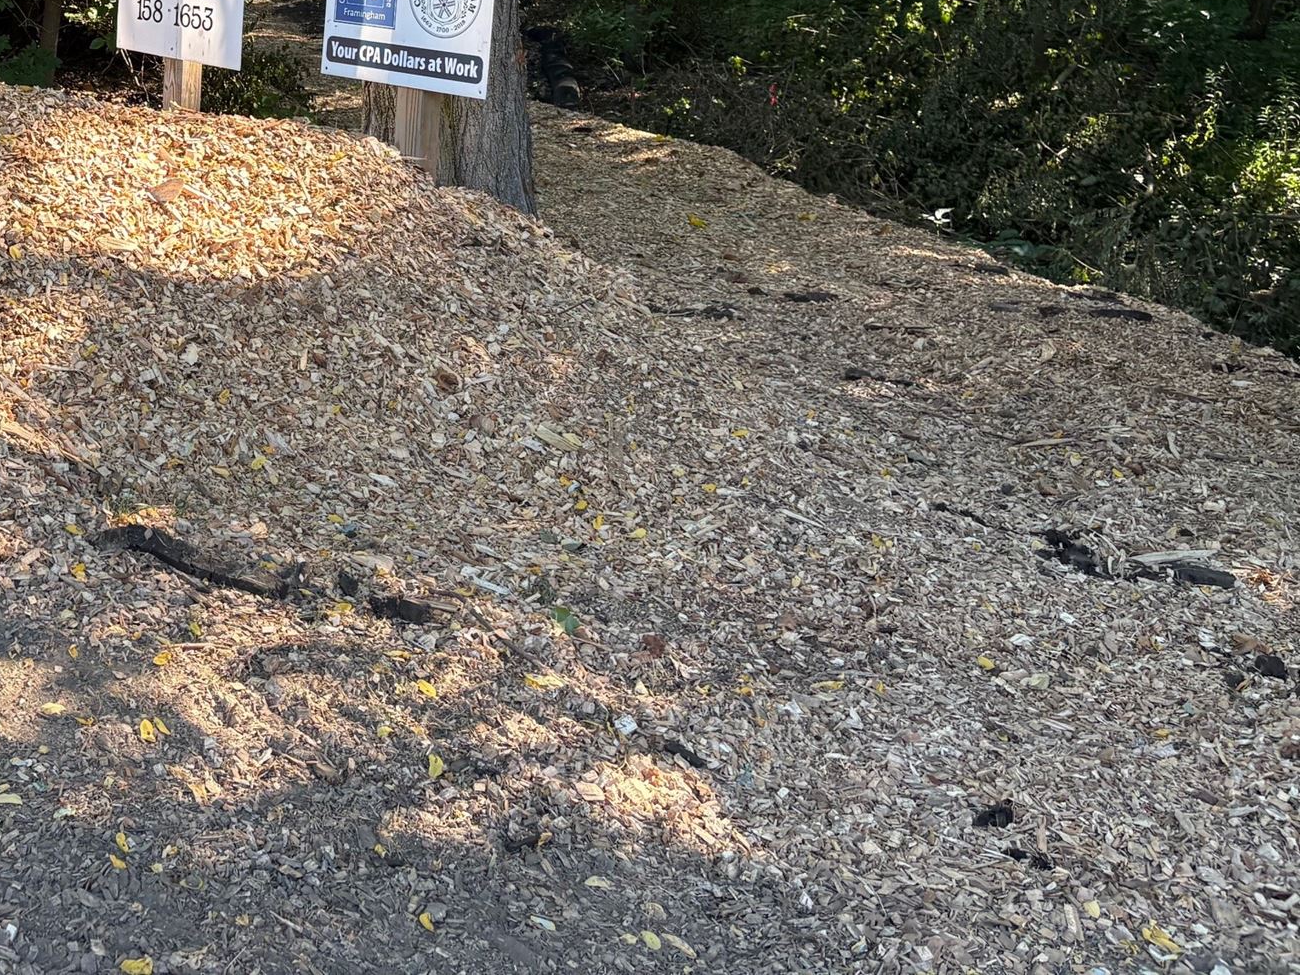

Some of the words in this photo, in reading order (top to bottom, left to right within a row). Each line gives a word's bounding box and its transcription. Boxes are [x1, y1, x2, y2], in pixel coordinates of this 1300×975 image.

[343, 8, 386, 20] Framingham
[331, 40, 358, 60] Your
[359, 45, 381, 64] CPA
[384, 50, 426, 70] Dollars
[428, 58, 442, 74] at
[444, 56, 478, 78] Work
